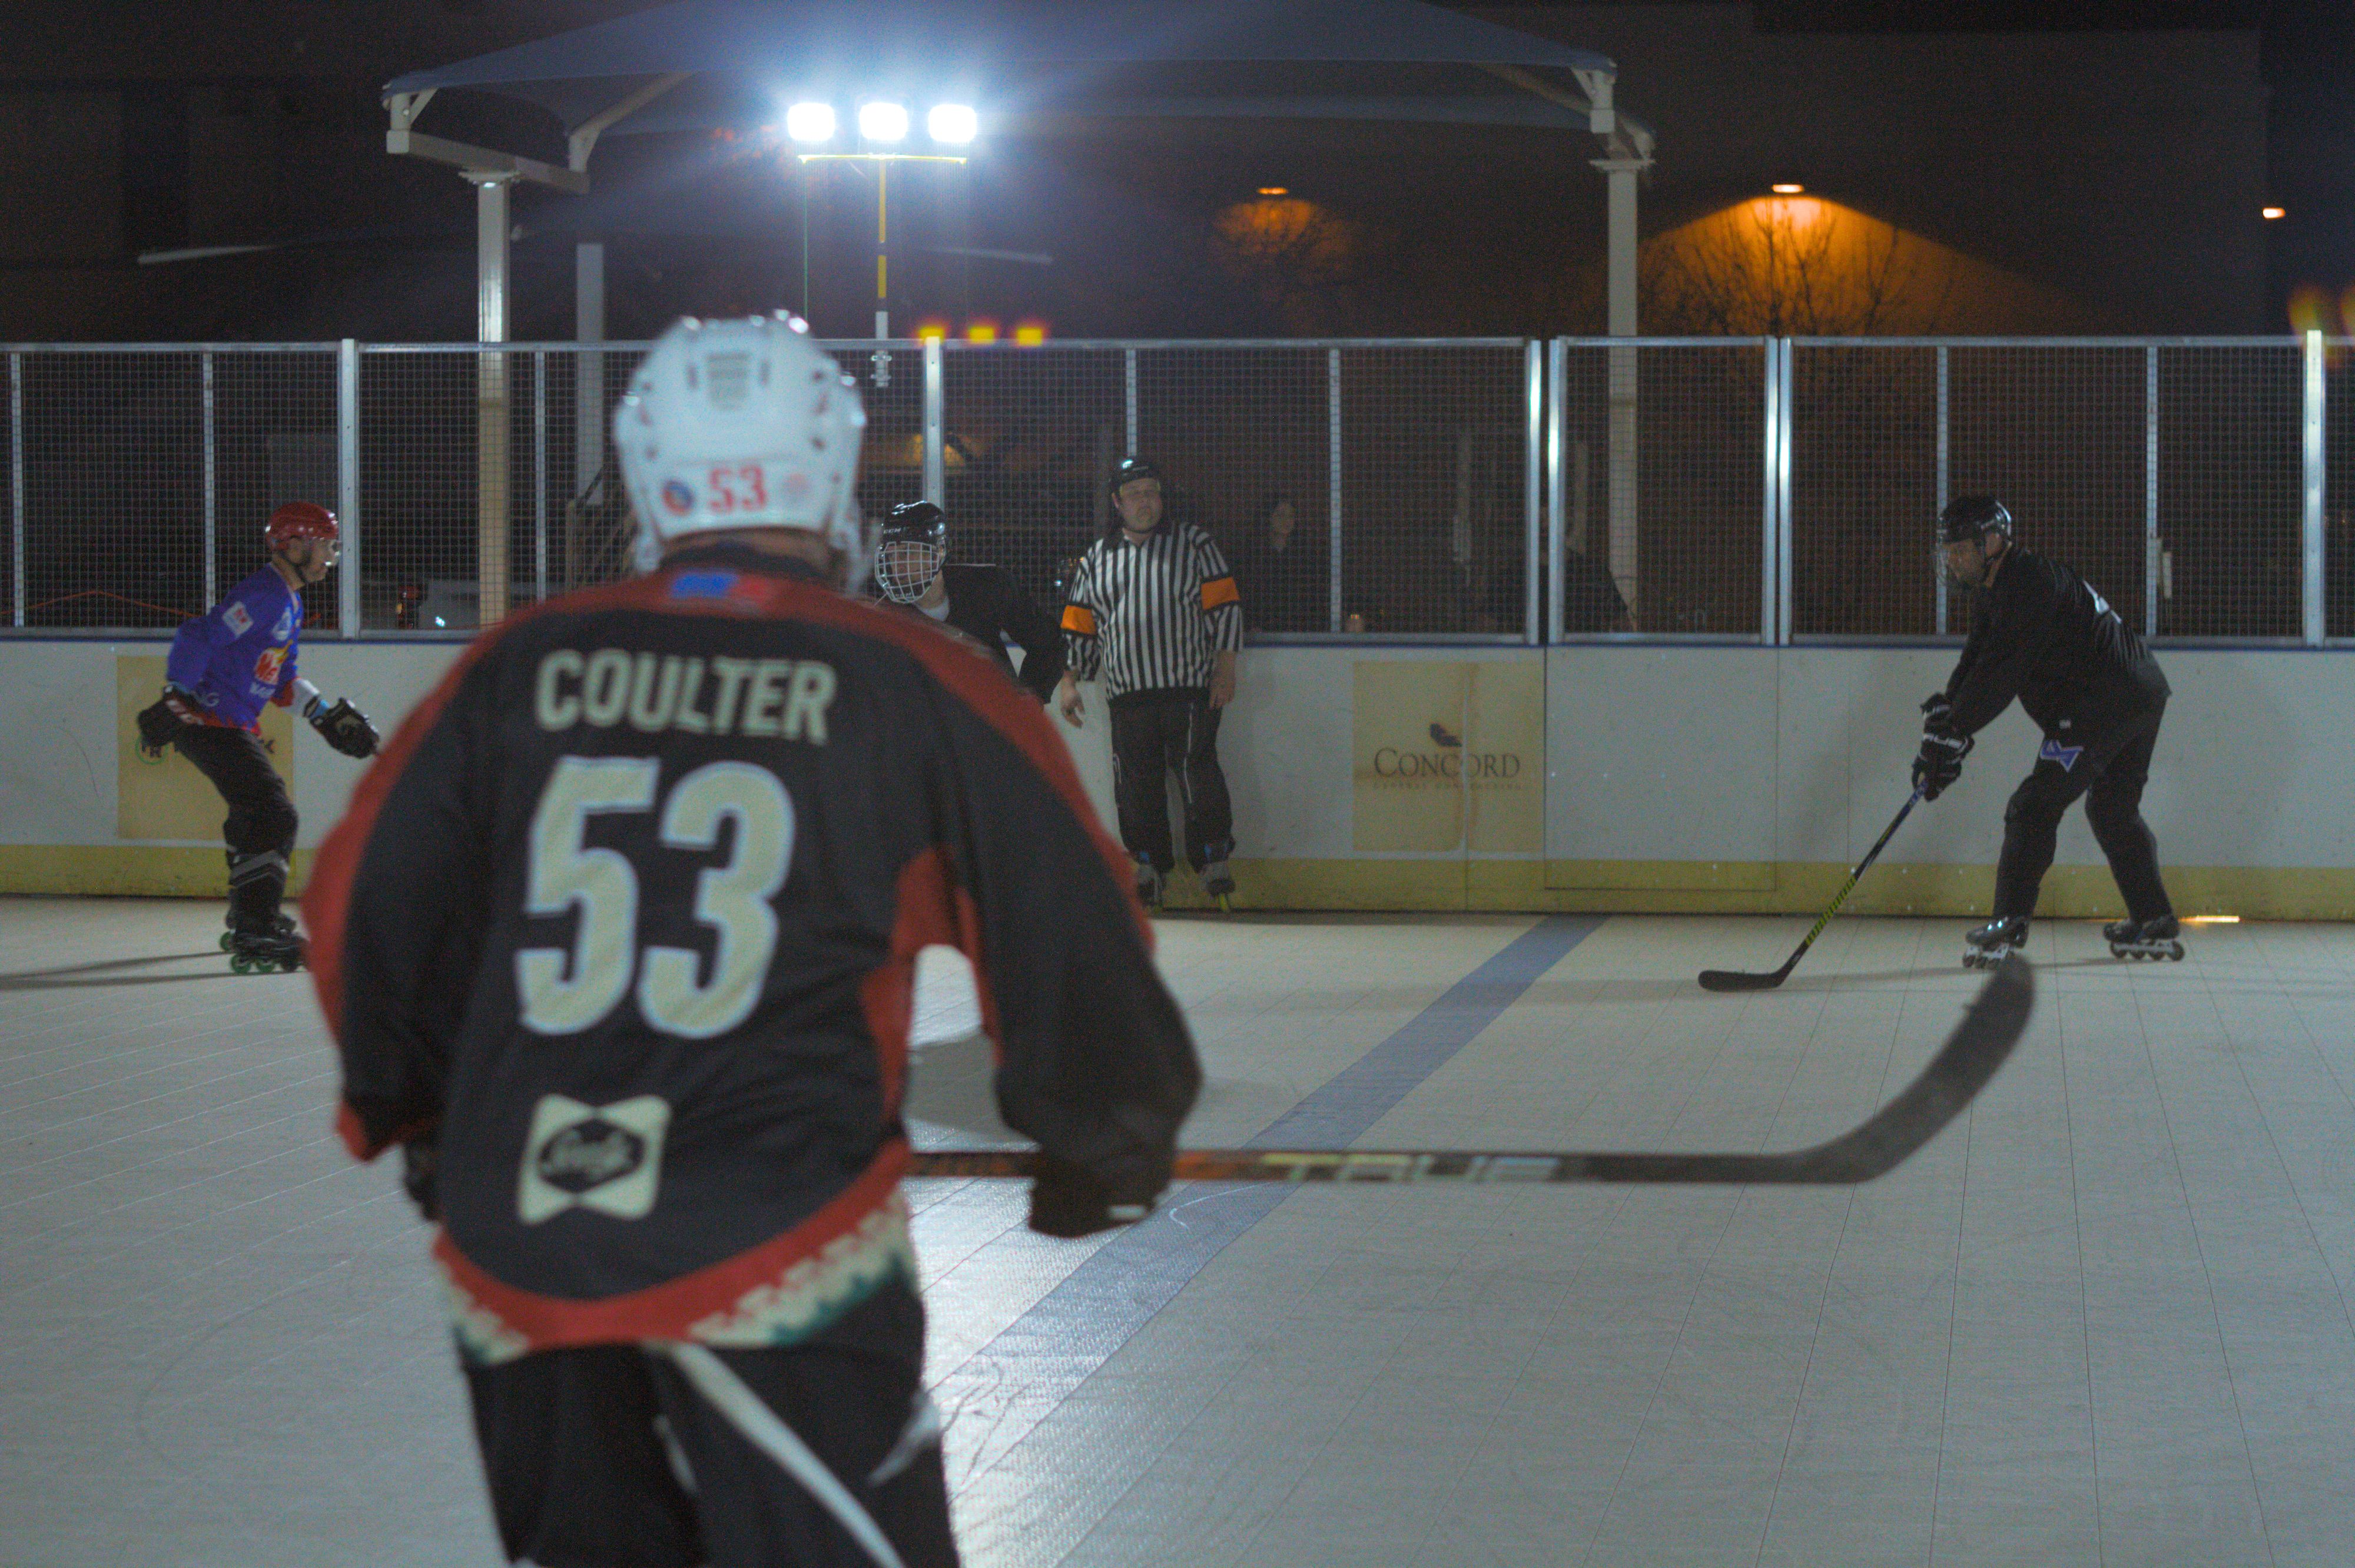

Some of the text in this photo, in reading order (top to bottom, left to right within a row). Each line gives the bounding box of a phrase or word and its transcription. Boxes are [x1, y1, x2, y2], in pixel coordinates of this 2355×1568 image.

[709, 465, 768, 513] 53
[535, 648, 838, 746] COULTER
[1374, 747, 1521, 778] CONCORD
[516, 755, 796, 1039] 53
